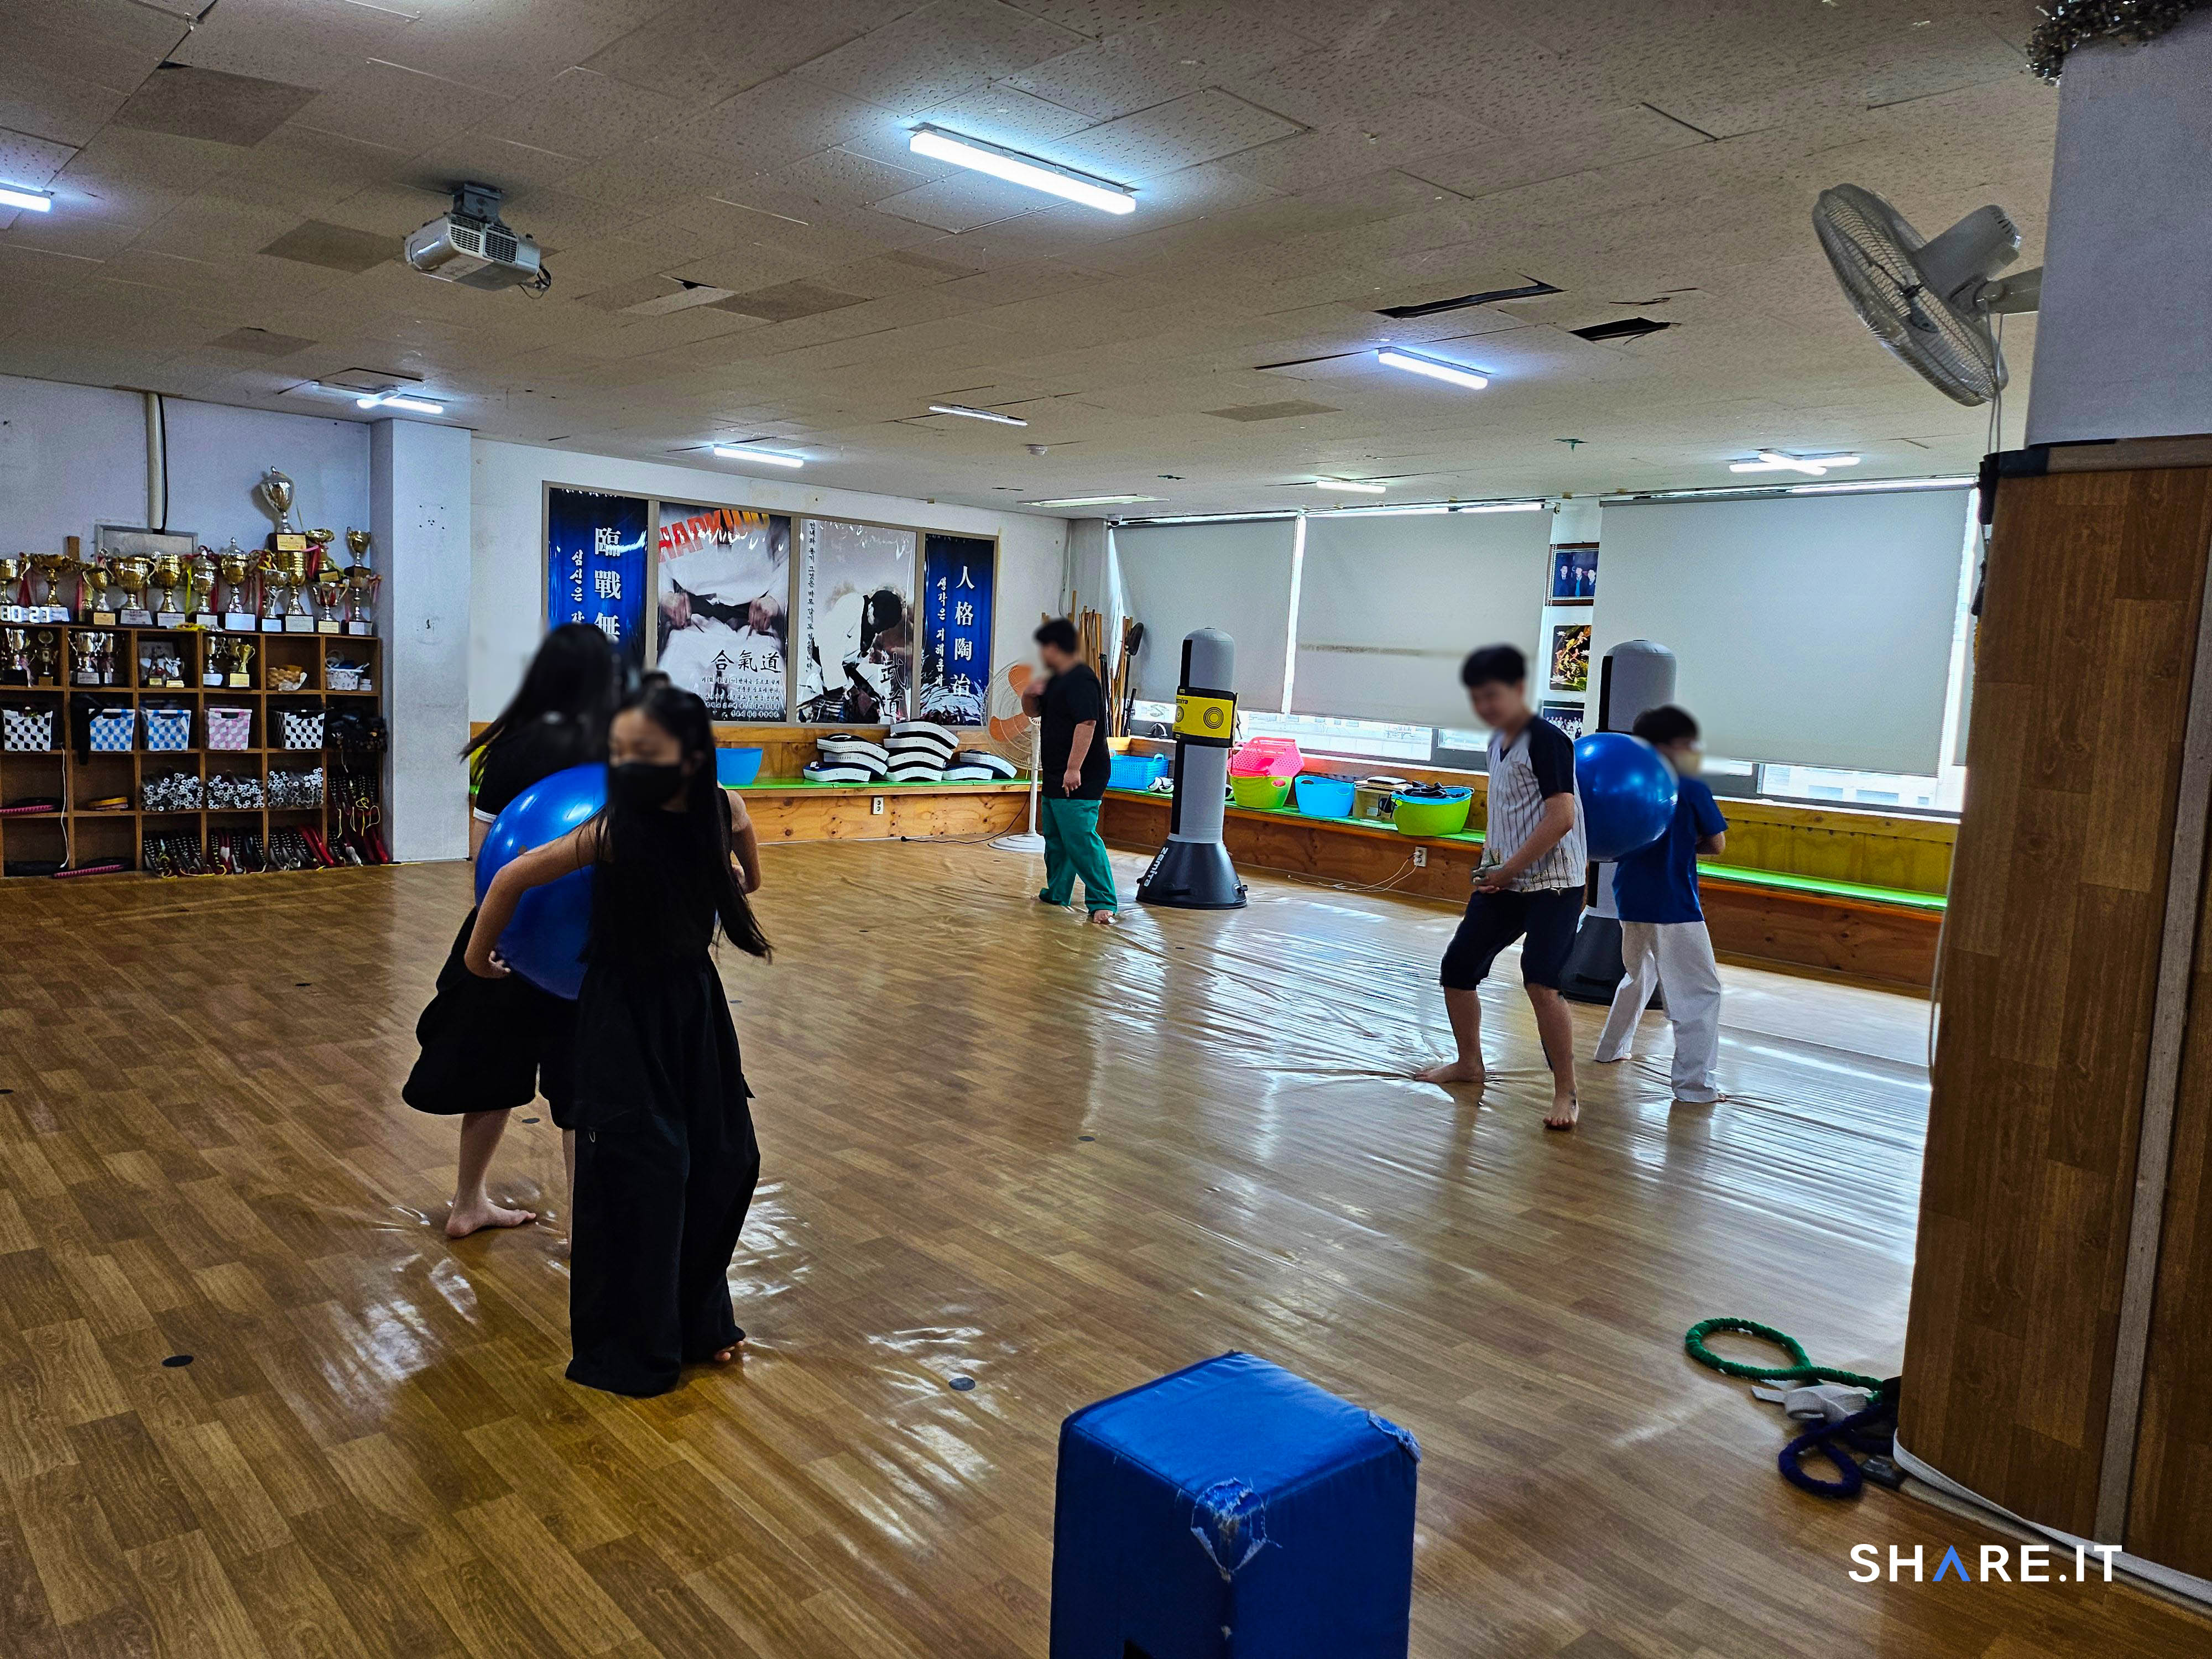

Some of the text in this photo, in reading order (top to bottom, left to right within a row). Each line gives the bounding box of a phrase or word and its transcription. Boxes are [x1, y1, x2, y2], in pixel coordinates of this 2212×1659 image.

[808, 547, 815, 562] 용기
[569, 549, 583, 602] 심신은
[807, 590, 815, 604] 바로
[935, 577, 947, 687] 생각은 지혜롭게
[711, 649, 782, 673] 合氣道
